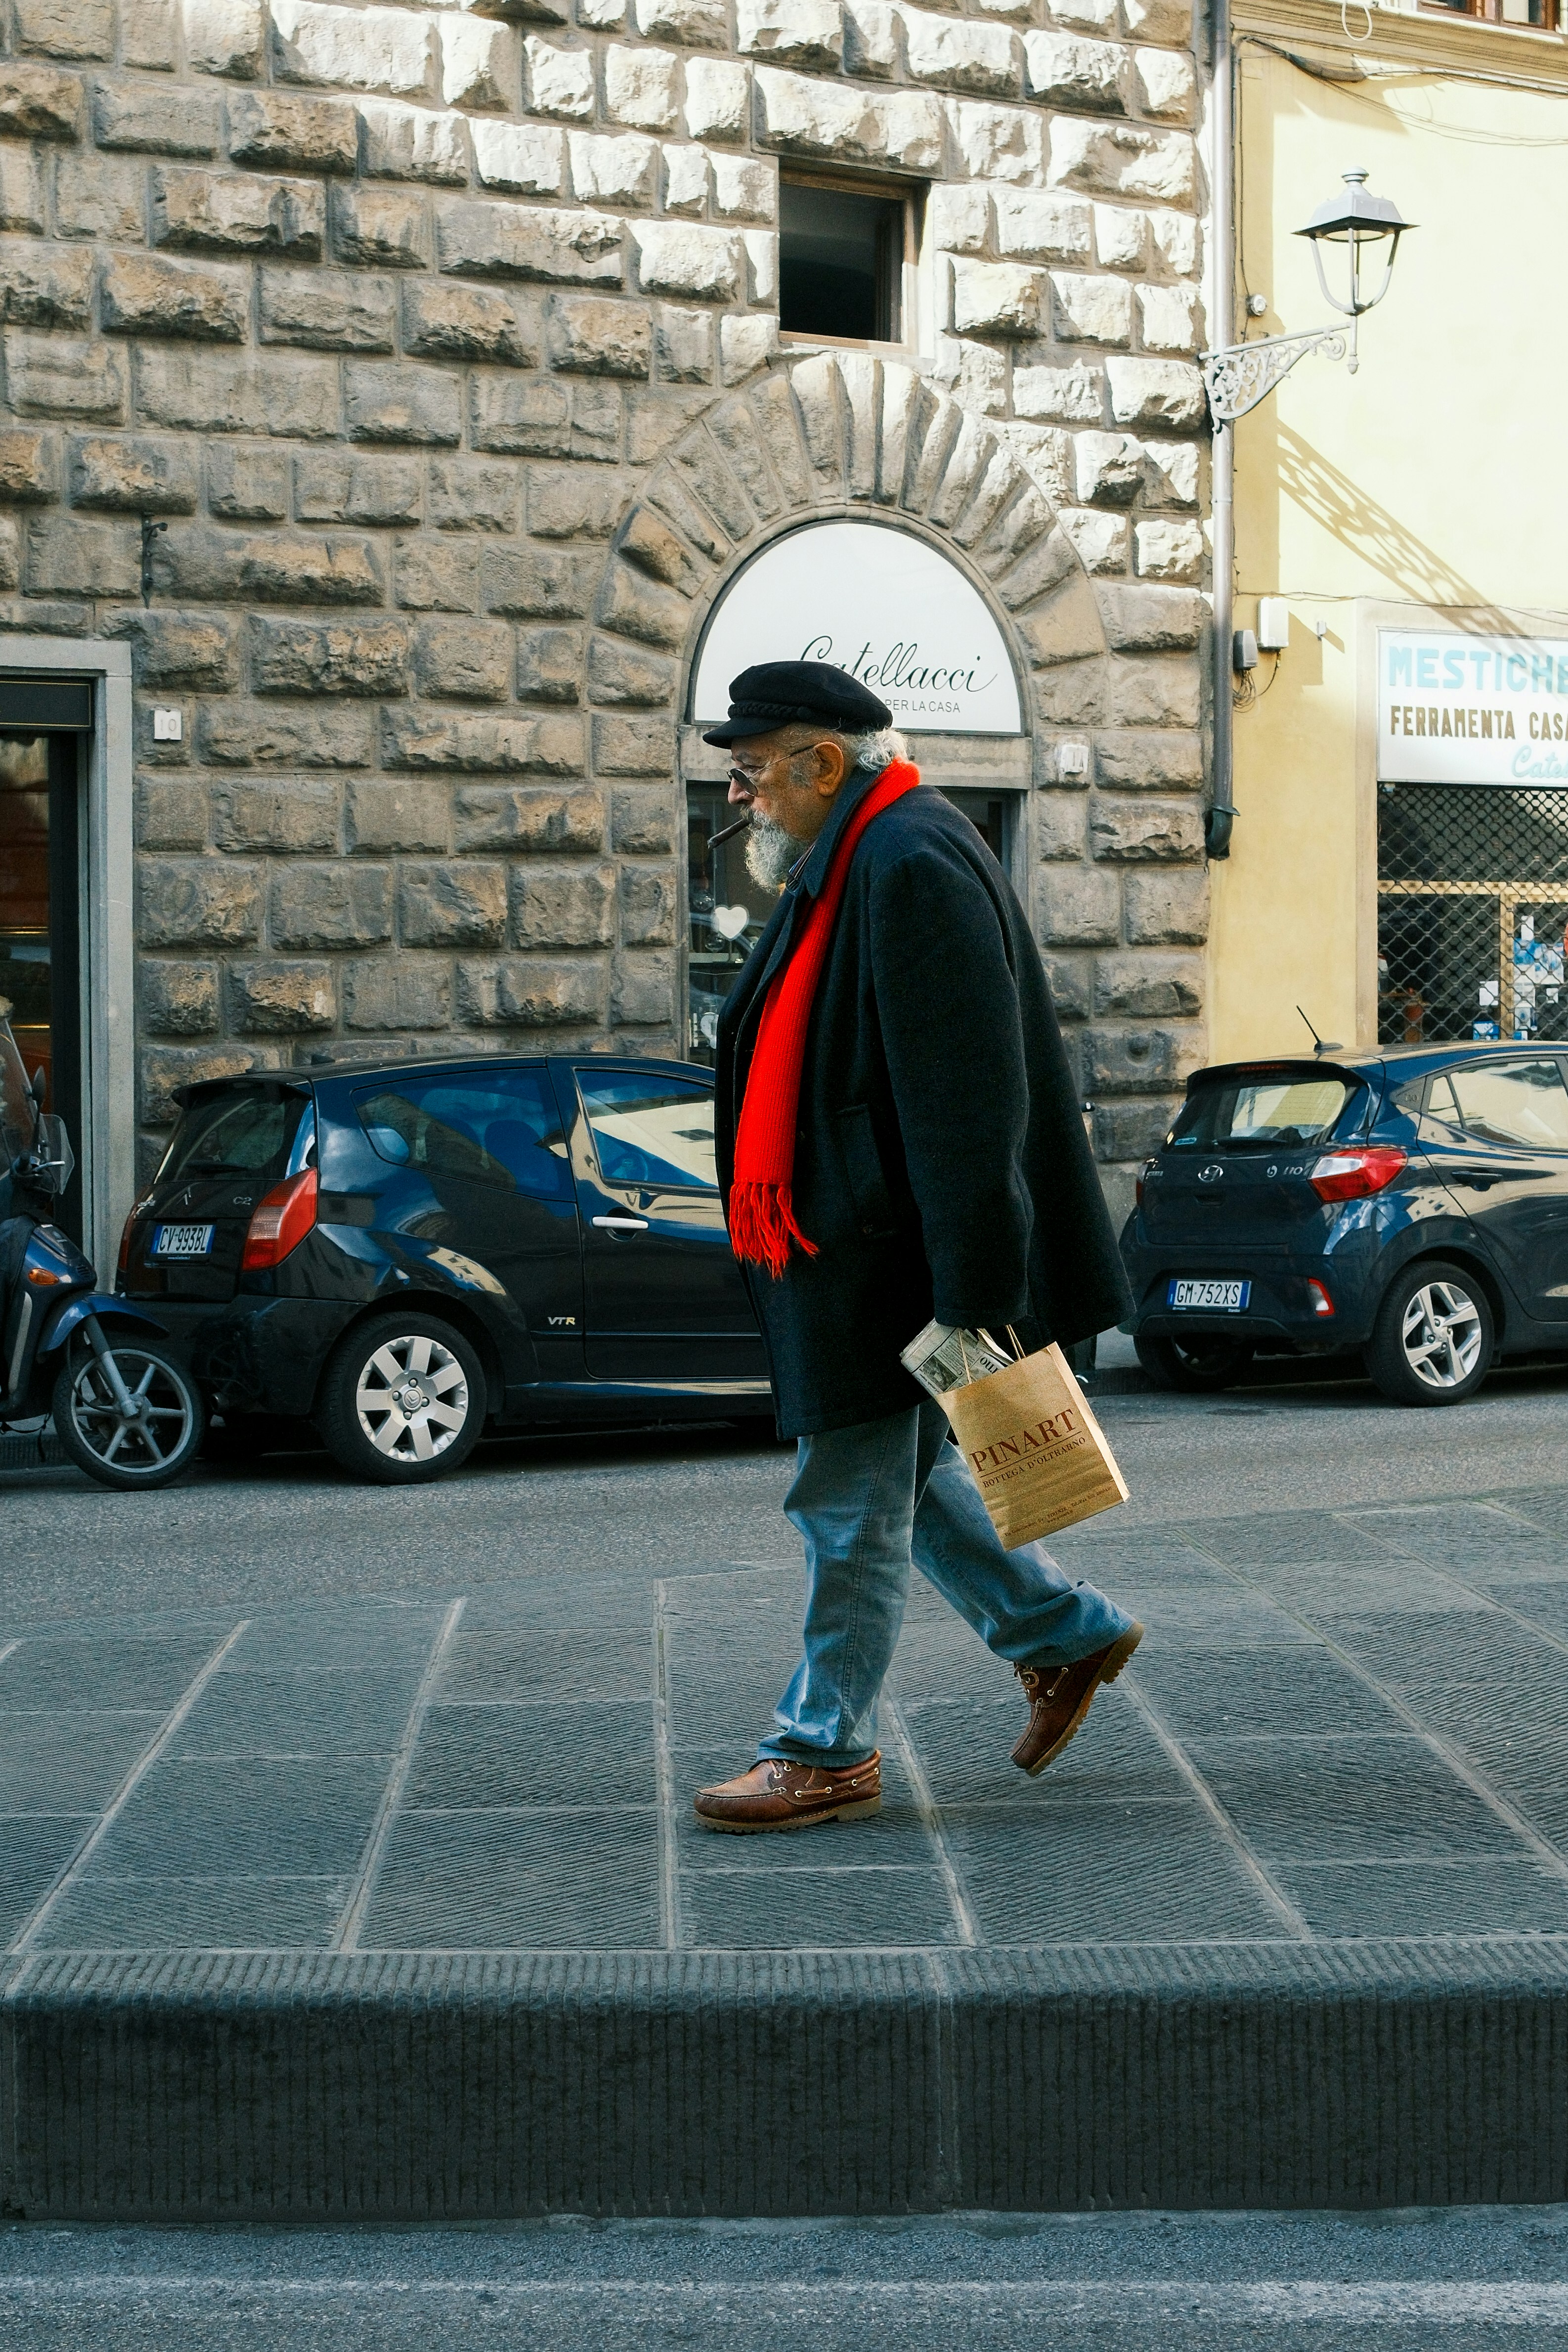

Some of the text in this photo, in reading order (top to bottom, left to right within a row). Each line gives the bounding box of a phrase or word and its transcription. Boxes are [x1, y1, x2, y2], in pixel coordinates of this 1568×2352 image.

[800, 635, 998, 693] Ctellacci
[885, 699, 960, 713] PER LA CASA
[1391, 705, 1516, 740] FERRAMENTA
[233, 1196, 252, 1205] C2
[547, 1316, 575, 1325] VTR
[968, 1408, 1076, 1473] PINART
[982, 1437, 1086, 1488] BOTTEGA D'OLTRARNO
